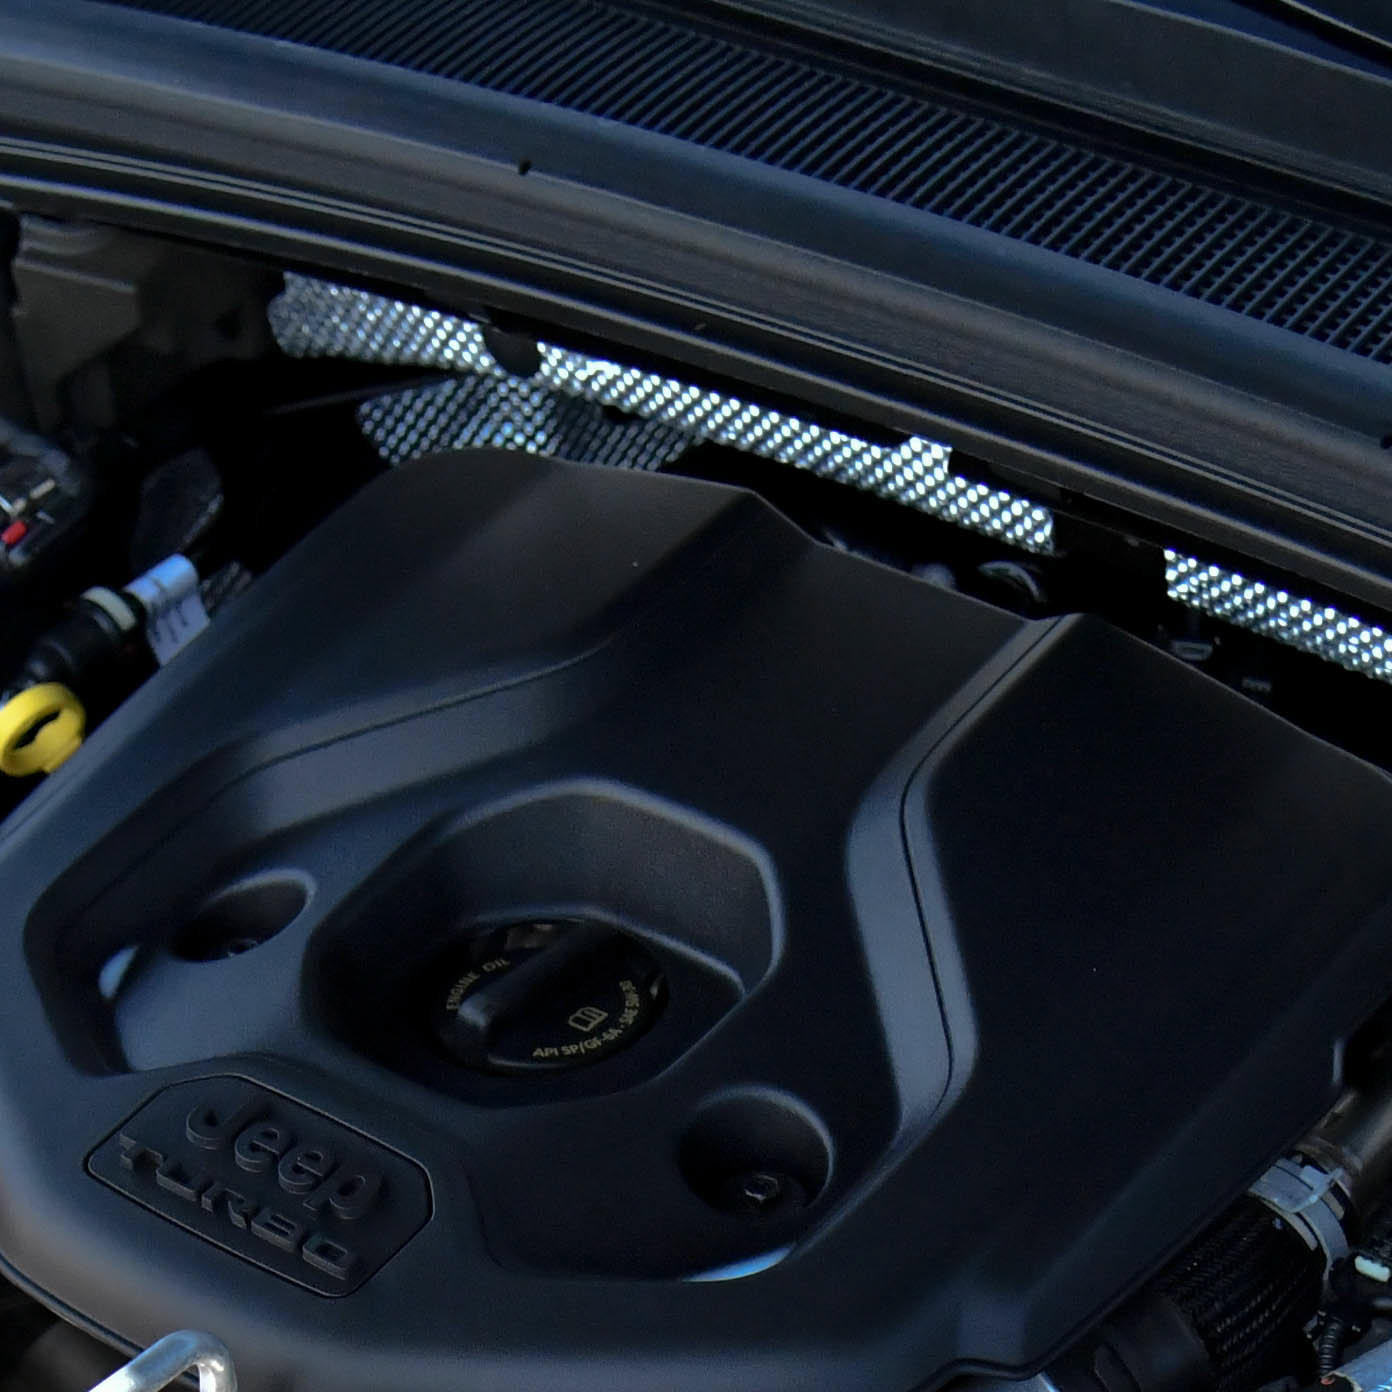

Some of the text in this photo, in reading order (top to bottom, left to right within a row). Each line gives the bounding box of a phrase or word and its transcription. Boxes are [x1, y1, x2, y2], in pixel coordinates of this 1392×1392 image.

[446, 957, 511, 1011] ENGINE OIL
[533, 1047, 558, 1058] API
[185, 1102, 380, 1220] Jeep
[119, 1133, 355, 1280] TURBO
